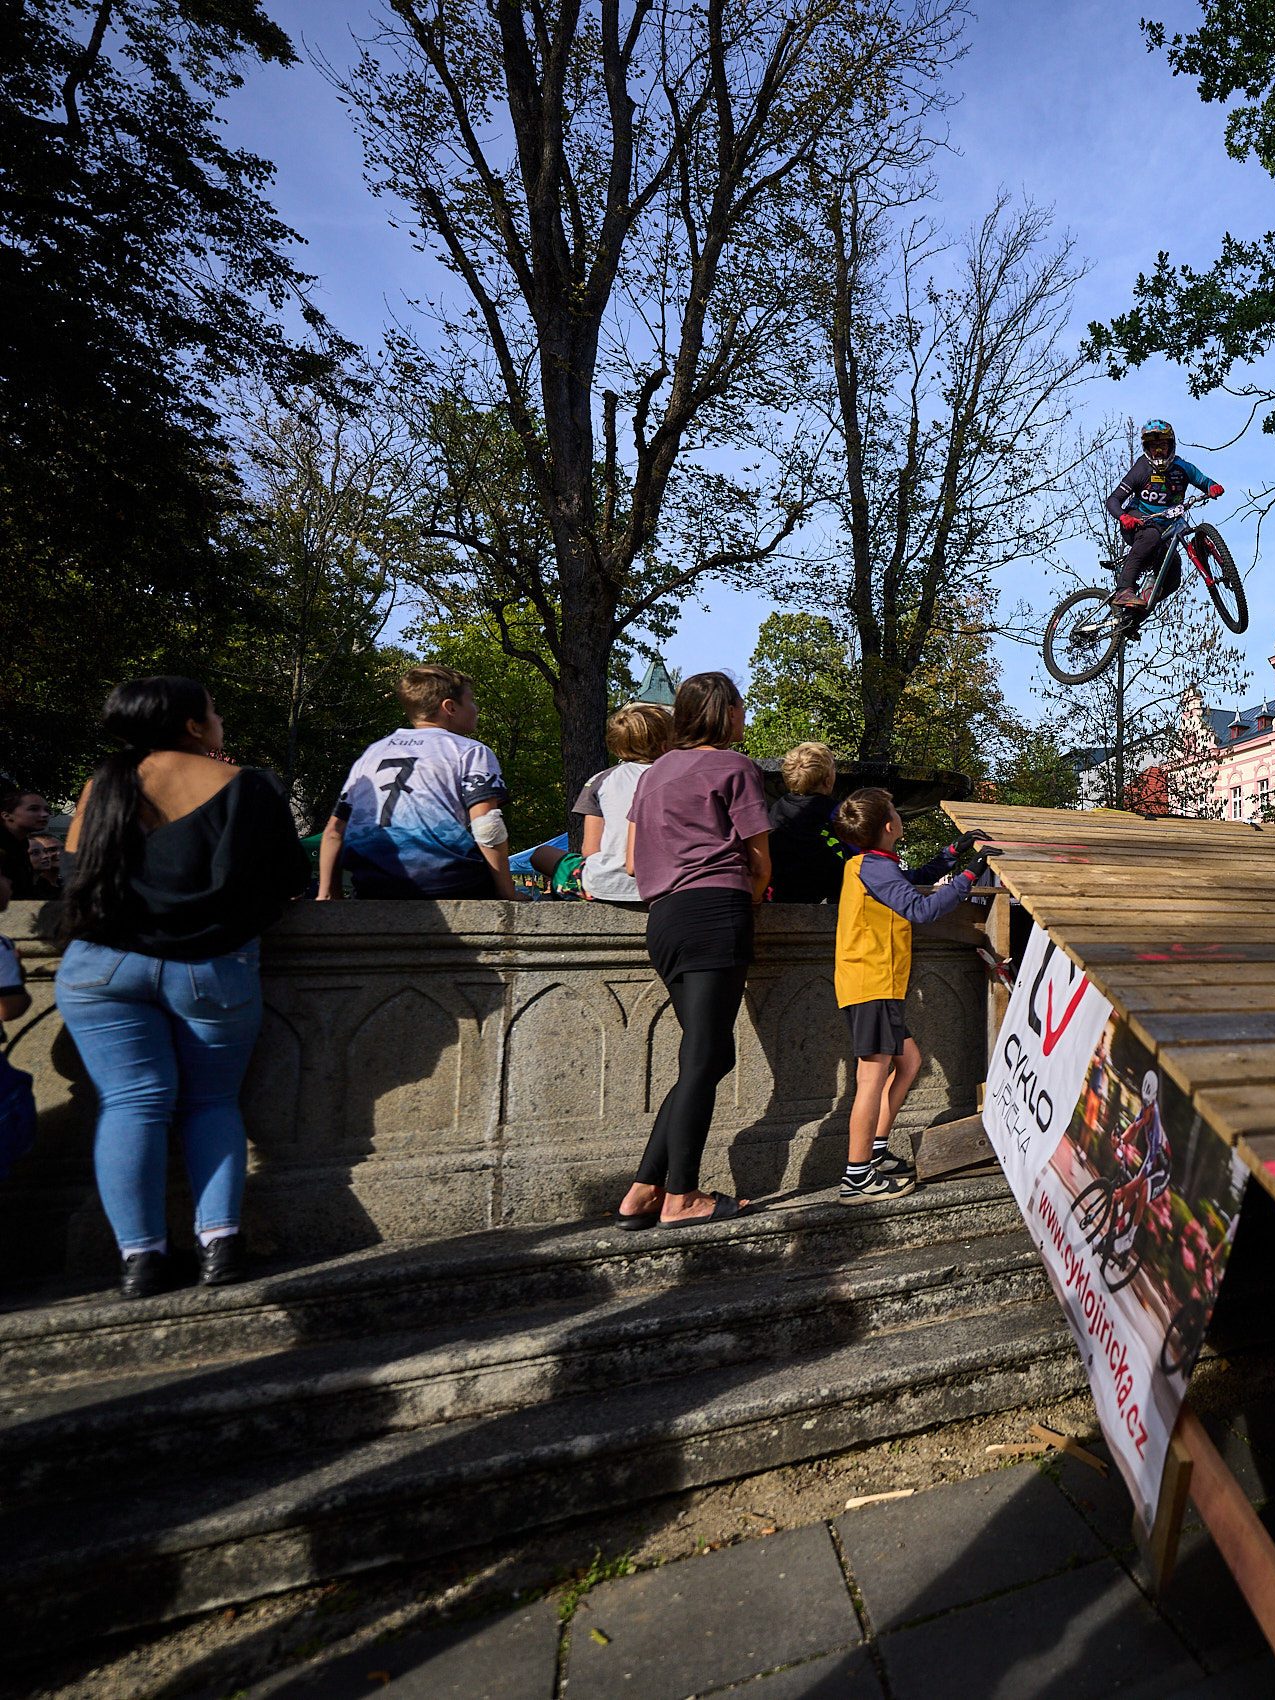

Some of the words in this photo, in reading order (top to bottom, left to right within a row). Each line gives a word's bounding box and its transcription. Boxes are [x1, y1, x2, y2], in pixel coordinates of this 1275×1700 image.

[387, 737, 424, 748] Kuba
[376, 757, 420, 828] 7
[1004, 1033, 1053, 1133] CYKLO
[1038, 1189, 1147, 1462] www.cyklojiricka.cz
